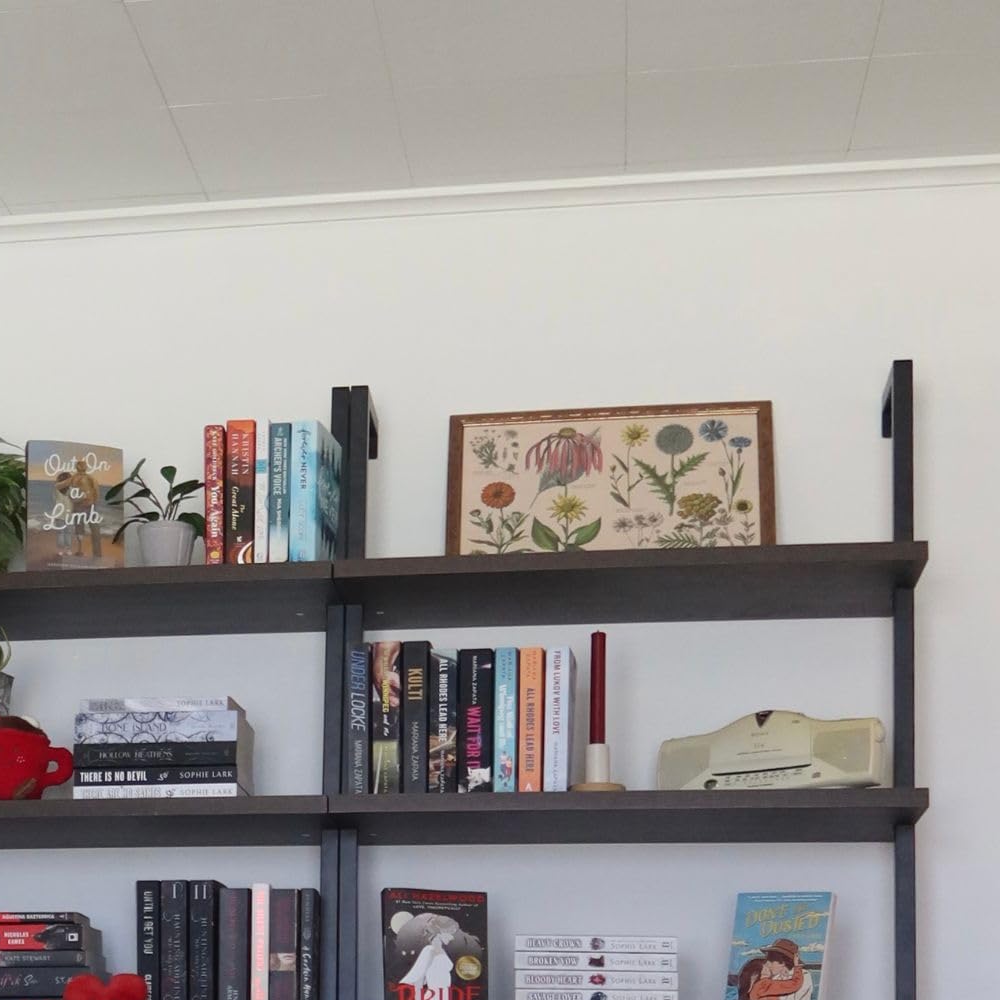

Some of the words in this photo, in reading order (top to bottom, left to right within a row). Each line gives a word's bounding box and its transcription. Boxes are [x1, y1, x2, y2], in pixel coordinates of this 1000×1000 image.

[44, 453, 78, 476] Out
[231, 432, 239, 475] HANNAH
[241, 432, 249, 475] KRISTIN
[273, 437, 282, 473] ARCHER'S
[231, 486, 239, 507] Great
[273, 474, 282, 496] VOICE
[43, 503, 103, 530] Limb
[210, 508, 221, 538] Again
[231, 508, 239, 531] Alone
[351, 651, 366, 691] UNDER
[439, 658, 449, 672] ALL
[552, 650, 561, 671] FROM
[408, 668, 423, 700] KULTI
[439, 673, 449, 703] RHODES
[526, 687, 537, 701] ALL
[552, 672, 561, 696] LUKOV
[351, 692, 366, 732] LOCKE
[438, 703, 448, 723] LEAD
[525, 702, 537, 731] RHODES
[552, 697, 561, 715] WITH
[466, 706, 483, 734] WAIT
[552, 716, 561, 735] LOVE
[411, 721, 419, 754] MARIANA
[438, 723, 448, 742] HERE
[526, 732, 537, 752] LEAD
[411, 755, 419, 781] ZAPATA
[525, 753, 536, 773] HERE
[79, 771, 103, 783] THERE
[104, 771, 113, 782] IS
[114, 771, 125, 781] NO
[126, 770, 148, 781] DEVIL
[178, 771, 208, 779] SOPHIE
[211, 770, 232, 778] LARK
[355, 769, 365, 795] ZAPATA
[143, 891, 153, 913] UNTIL
[143, 939, 154, 955] YOU
[527, 956, 560, 967] BROKEN
